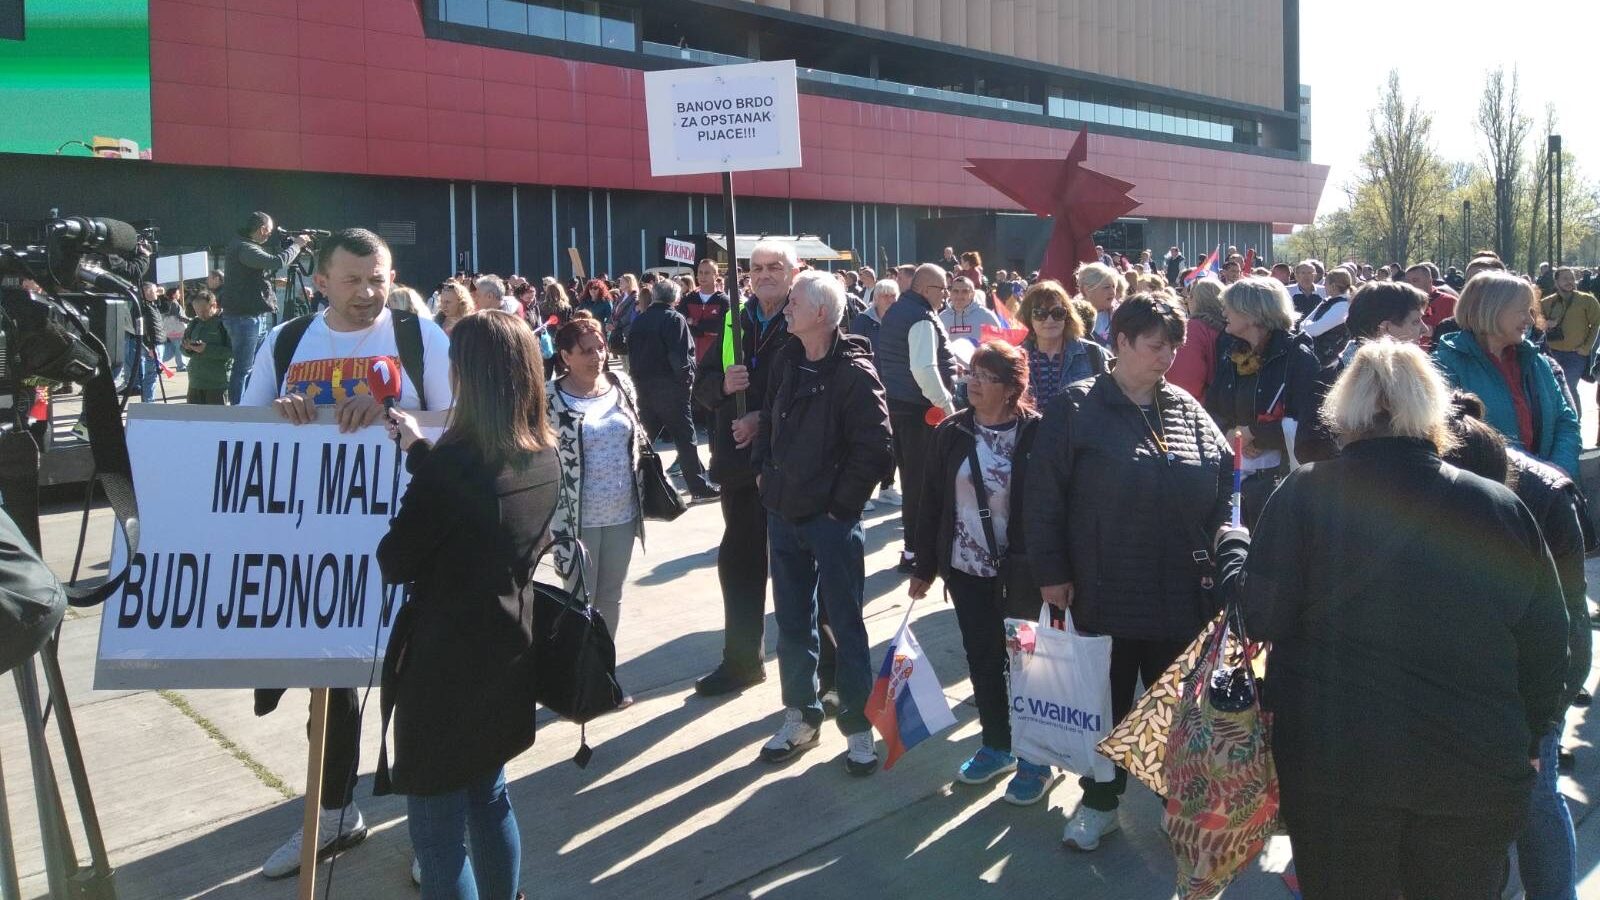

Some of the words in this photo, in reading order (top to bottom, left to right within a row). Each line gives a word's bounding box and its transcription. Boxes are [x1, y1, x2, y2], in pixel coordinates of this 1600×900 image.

[677, 99, 732, 113] BANOVO
[736, 96, 773, 109] BRDO
[681, 116, 698, 128] ZA
[700, 111, 772, 127] OPSTANAK
[697, 128, 756, 141] PIJACE!!!
[212, 440, 304, 529] MALI,
[118, 553, 211, 629] BUDI
[216, 553, 369, 629] JEDNOM
